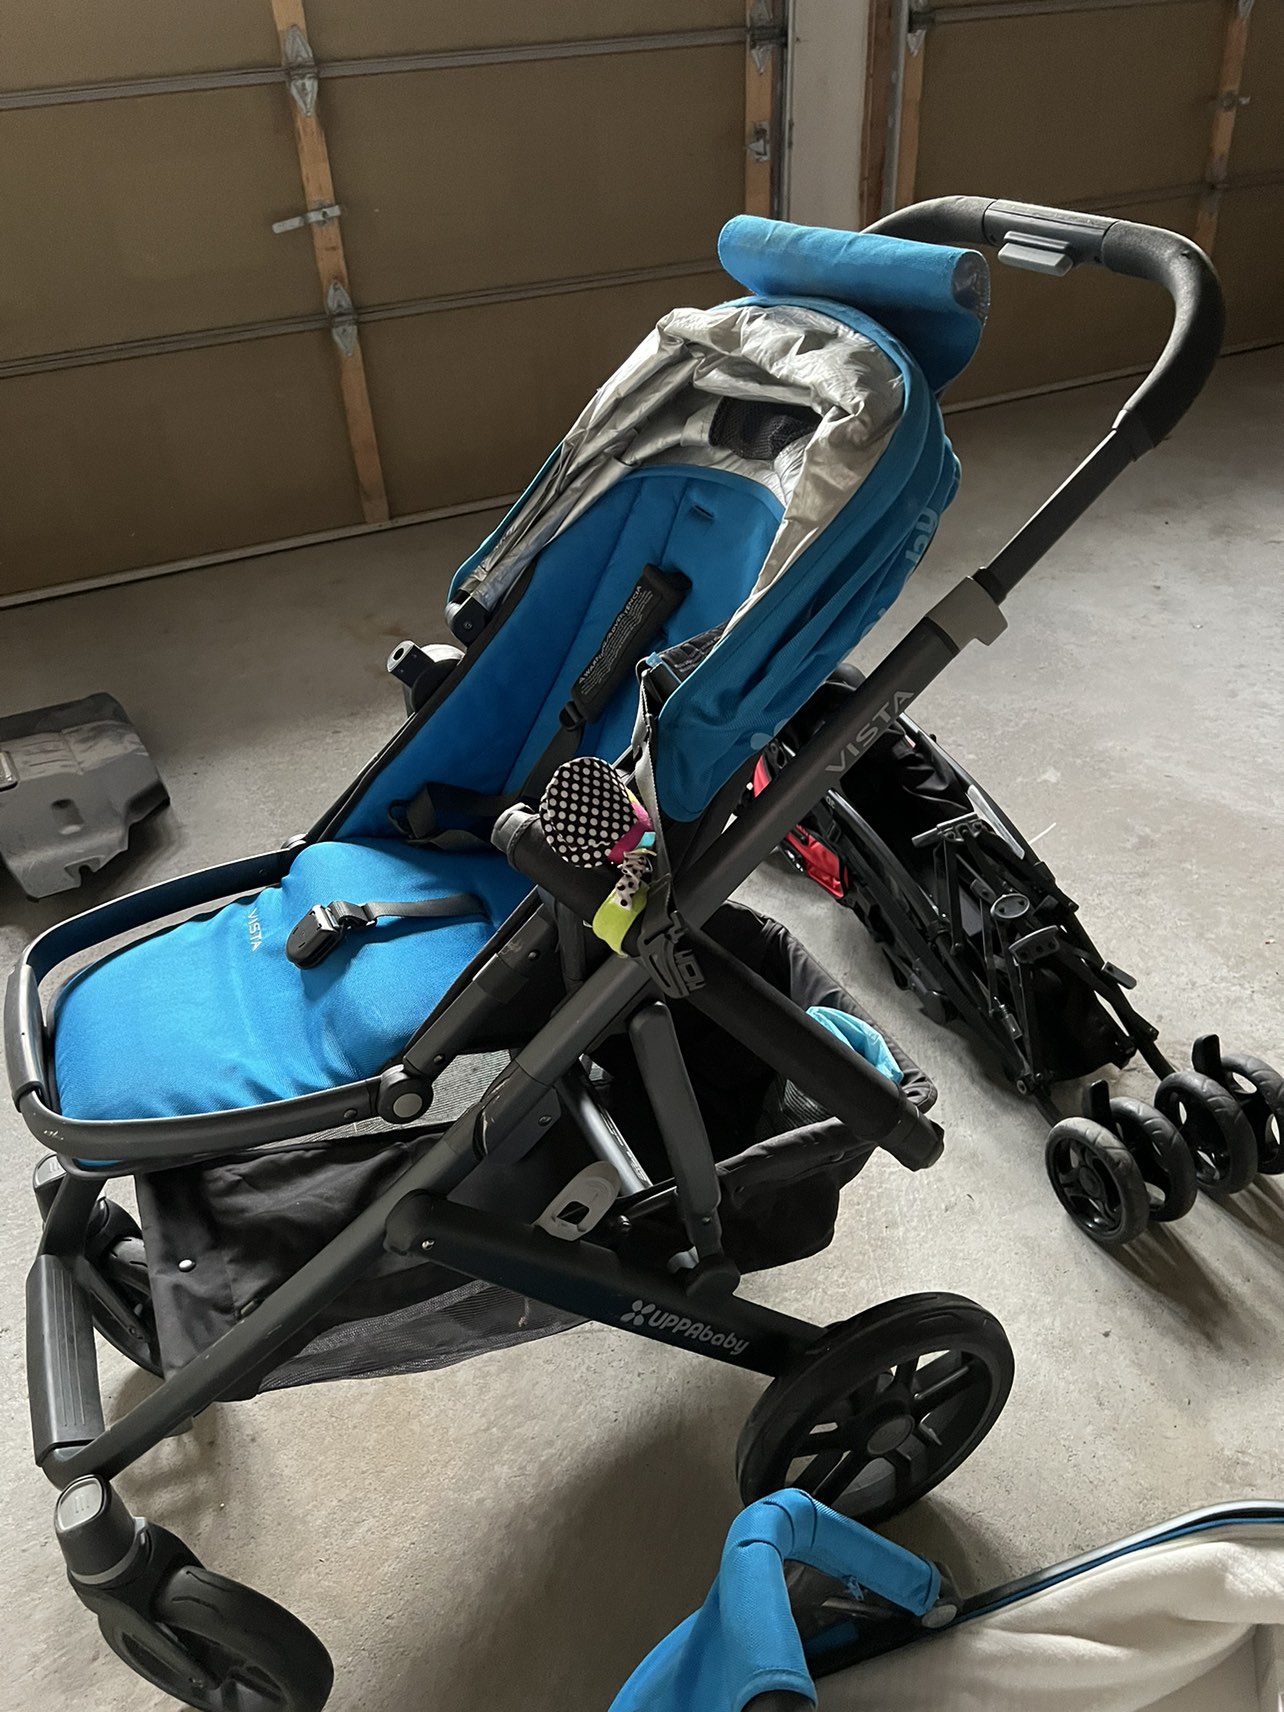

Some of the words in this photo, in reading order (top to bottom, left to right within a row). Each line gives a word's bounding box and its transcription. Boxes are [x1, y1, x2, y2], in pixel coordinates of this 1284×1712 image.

[825, 691, 915, 772] VISTA
[247, 907, 262, 952] VISTA
[648, 1310, 749, 1355] UPPAbaby
